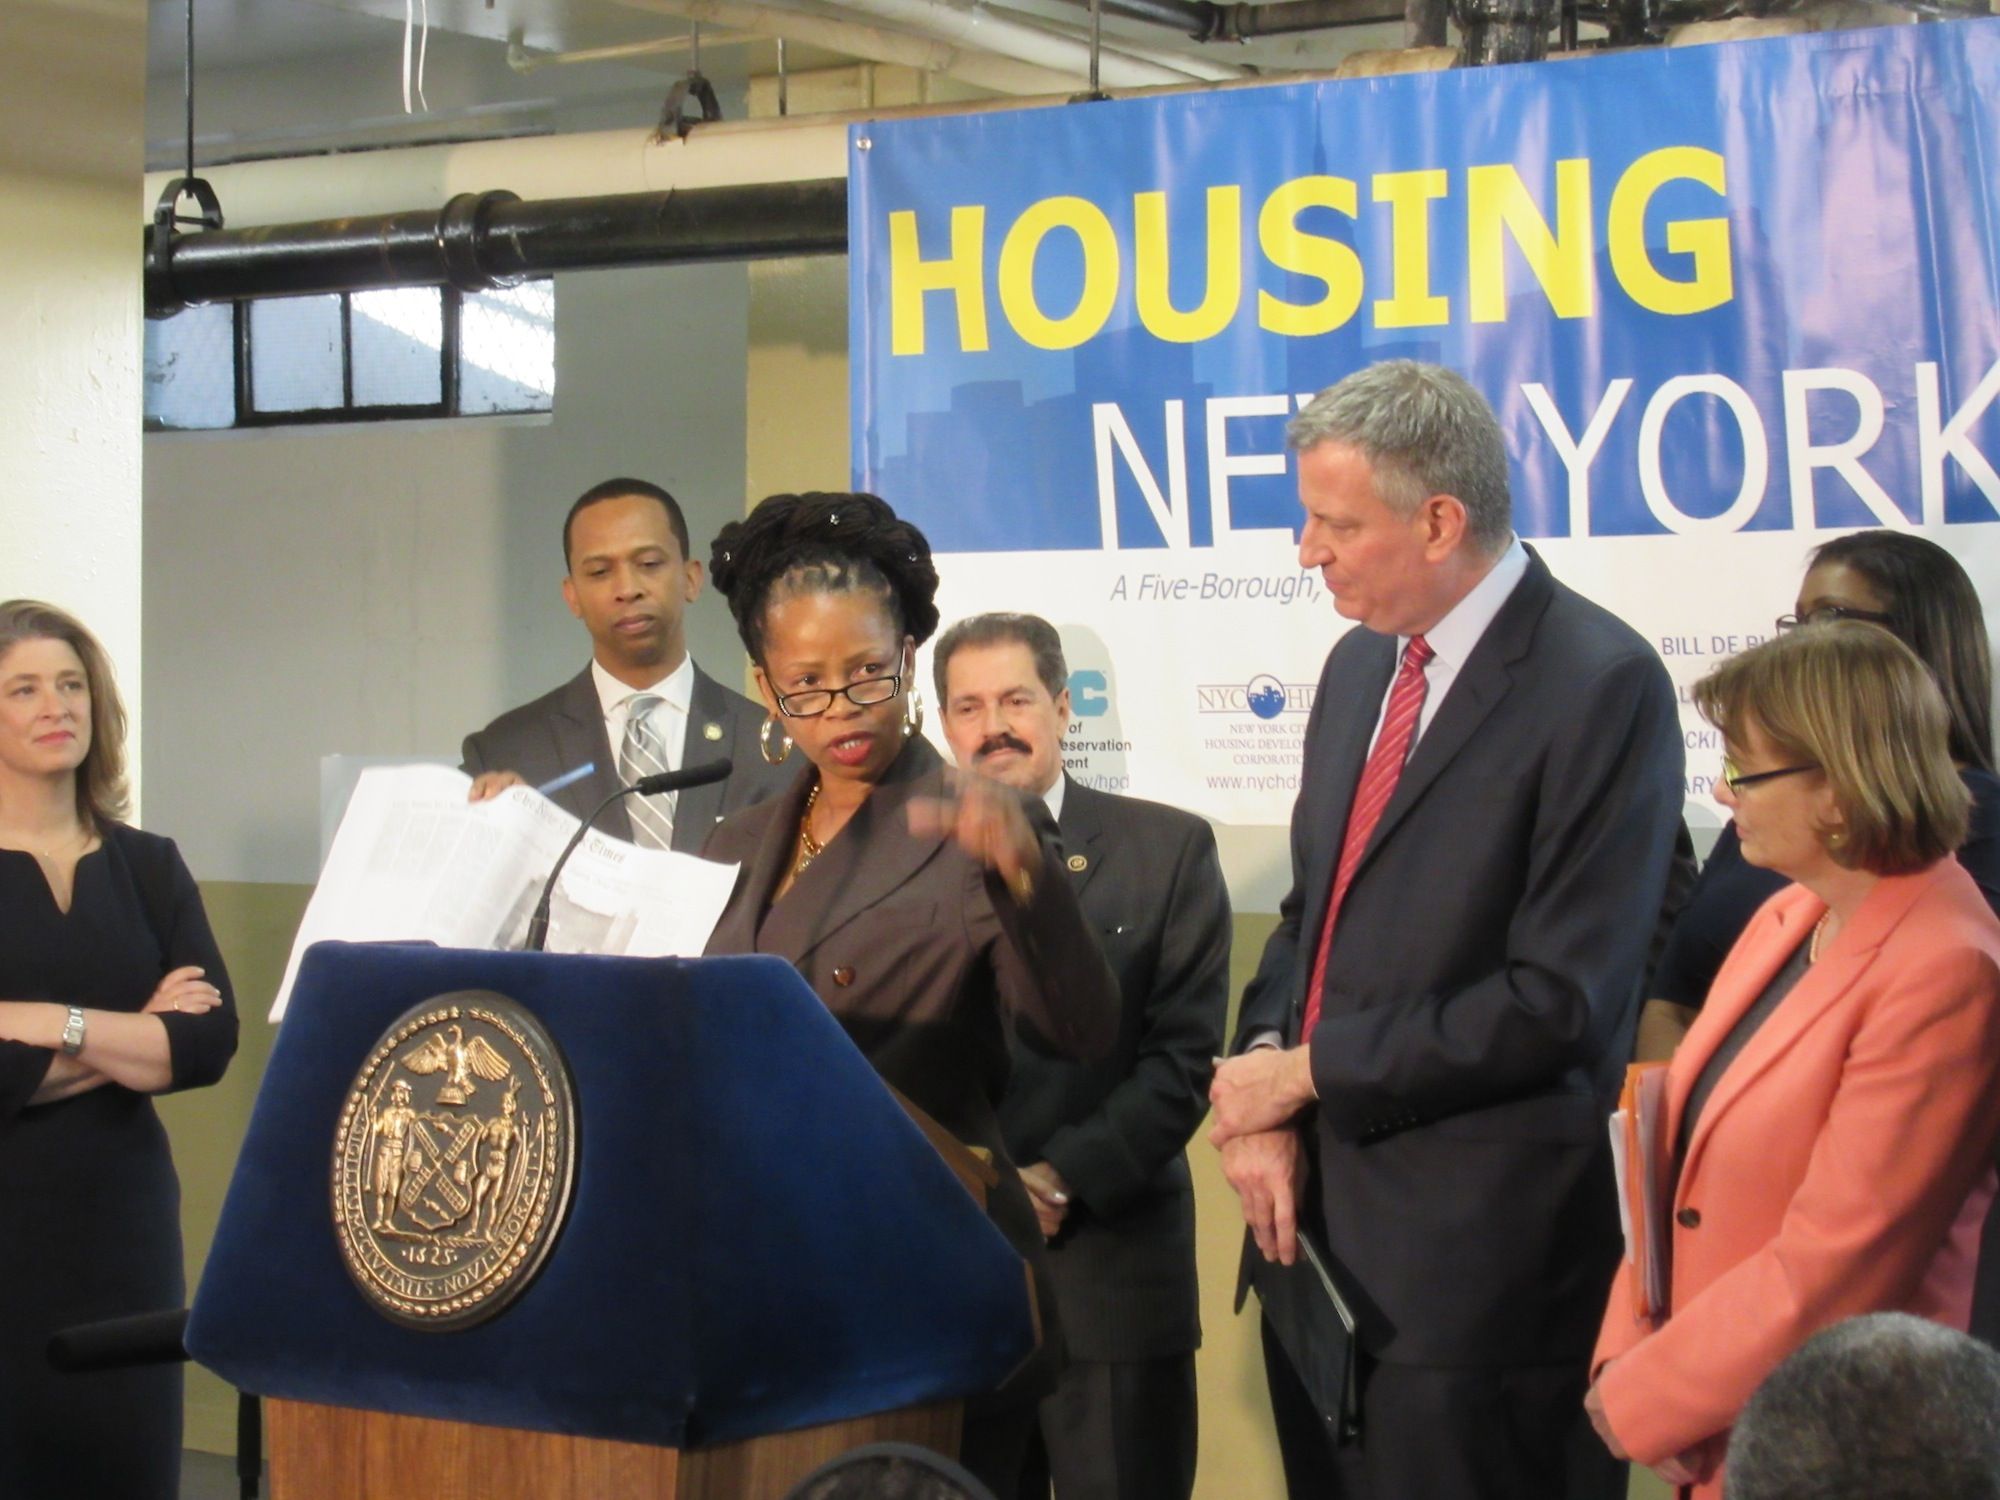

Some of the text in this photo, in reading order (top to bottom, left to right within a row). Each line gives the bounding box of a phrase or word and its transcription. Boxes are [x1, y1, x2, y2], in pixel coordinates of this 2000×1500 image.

[888, 145, 1734, 356] HOUSING
[1092, 358, 2000, 549] NE YORK
[1110, 569, 1321, 605] A Five-Borough,
[1661, 636, 1705, 656] BILL
[1711, 635, 1738, 655] DE
[1197, 688, 1247, 710] NYC
[1068, 721, 1083, 735] of
[1229, 723, 1306, 735] NEW YORK CIT
[1060, 739, 1132, 752] eservation
[1204, 738, 1302, 750] HOUSING DEVELO
[1685, 730, 1716, 750] CKI
[1233, 754, 1303, 765] CORPORATIO
[443, 1256, 491, 1294] NOVI
